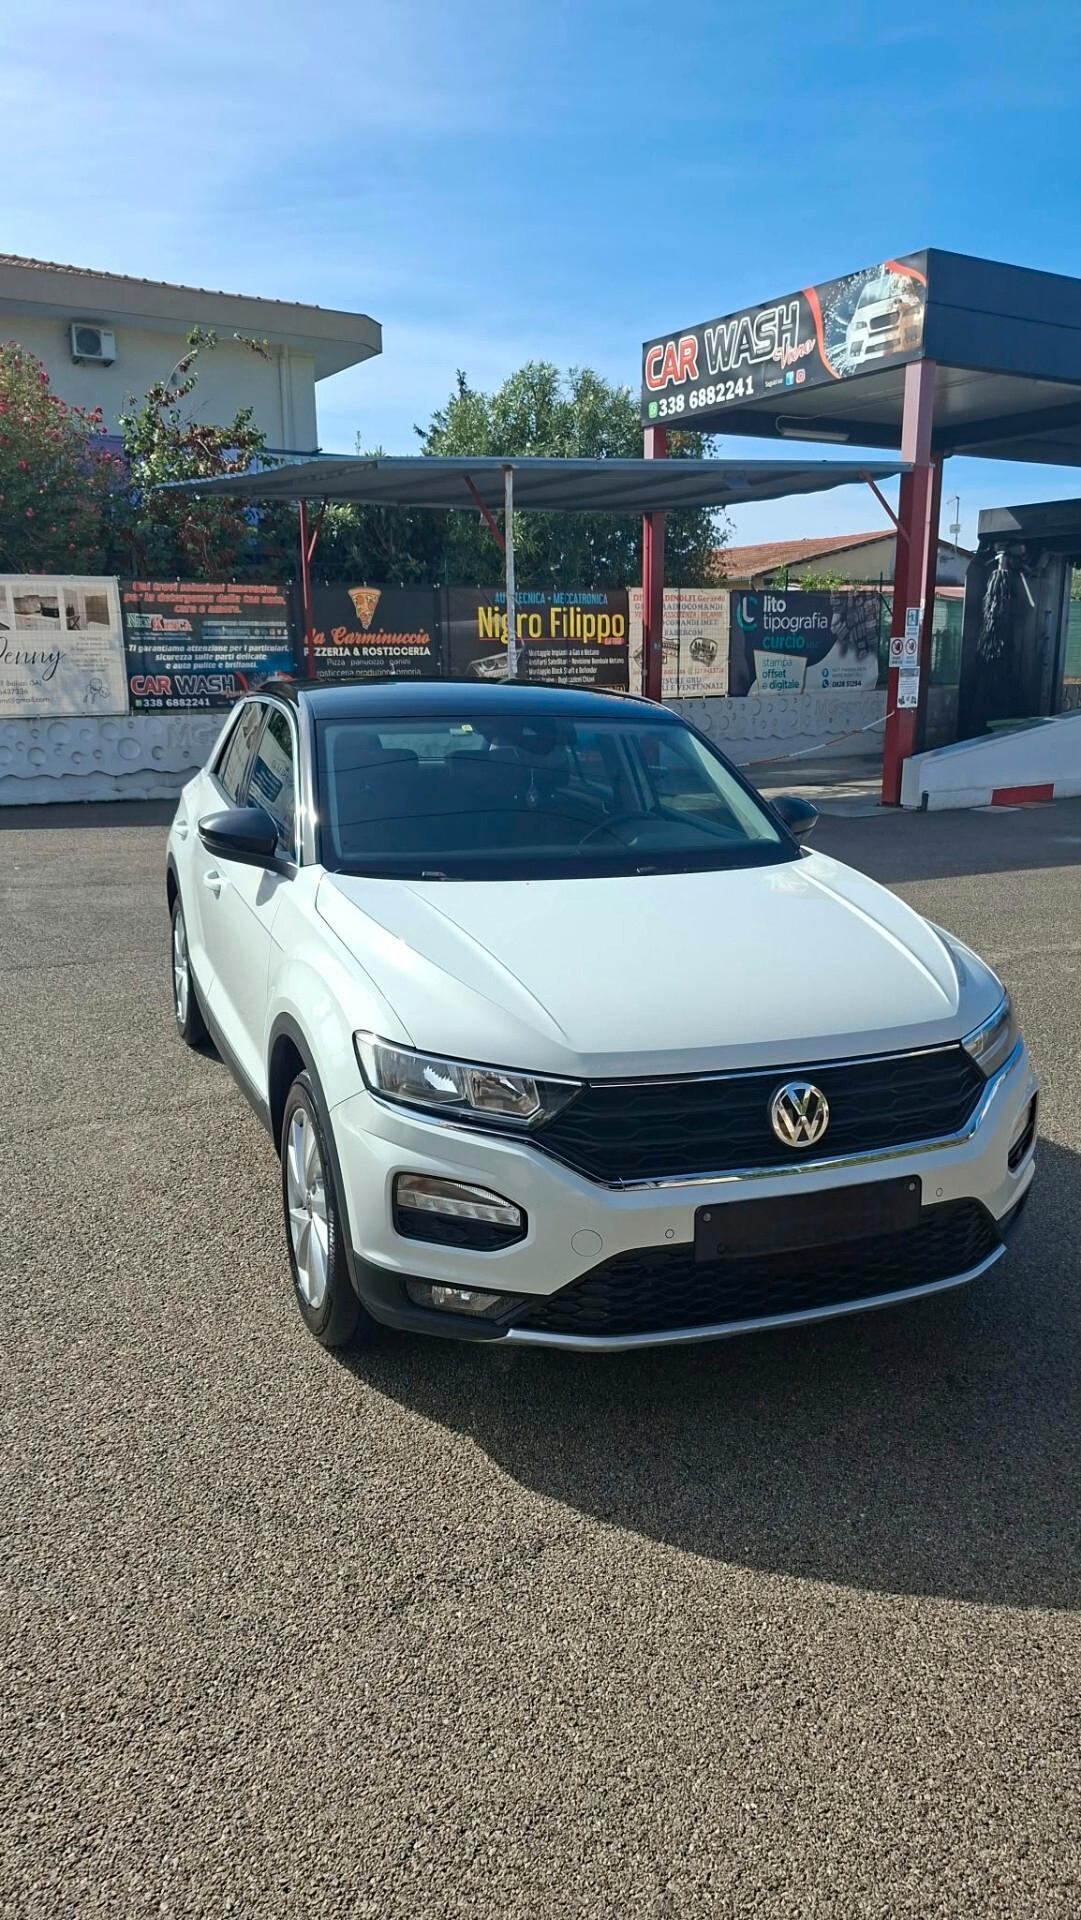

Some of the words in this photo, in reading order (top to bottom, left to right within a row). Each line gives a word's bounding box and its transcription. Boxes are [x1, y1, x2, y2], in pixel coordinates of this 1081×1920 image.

[645, 335, 700, 391] CAR
[704, 301, 801, 376] WASH
[658, 394, 685, 417] 338
[689, 375, 754, 409] 6882241
[495, 592, 546, 604] AUTECNICA
[554, 592, 608, 606] MECCATRONICA
[763, 596, 786, 612] lito
[478, 606, 542, 644] Nigro
[550, 606, 624, 644] Filippo
[763, 612, 828, 632] tipografia
[331, 626, 432, 645] Carminuccio
[762, 634, 805, 649] curcio
[138, 644, 185, 653] garantiamo
[304, 647, 351, 656] PZZERIA
[352, 647, 360, 656] &
[362, 646, 432, 656] ROSTICCERIA
[155, 653, 192, 661] sicurezza
[214, 654, 234, 662] parti
[326, 658, 346, 666] Pizza
[762, 669, 786, 678] offset
[131, 675, 172, 696] CAR
[174, 675, 236, 696] WASH
[769, 680, 800, 691] digitale
[144, 699, 163, 708] 338
[166, 698, 210, 708] 6882241
